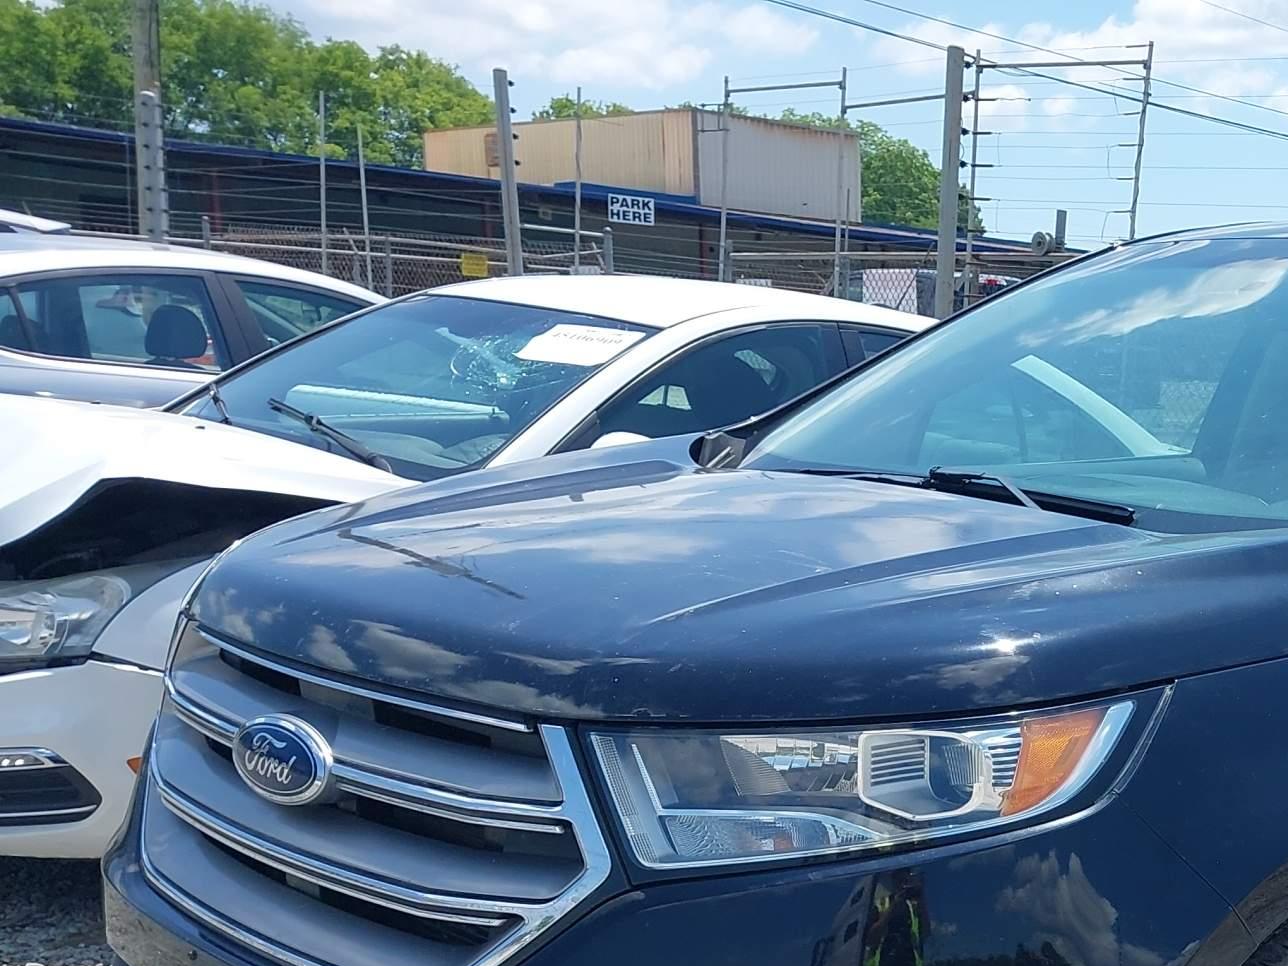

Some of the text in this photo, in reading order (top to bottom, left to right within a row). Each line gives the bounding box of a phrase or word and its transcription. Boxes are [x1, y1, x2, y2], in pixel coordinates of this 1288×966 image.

[610, 196, 652, 212] PARK
[610, 208, 653, 224] HERE
[244, 732, 297, 785] Ford
